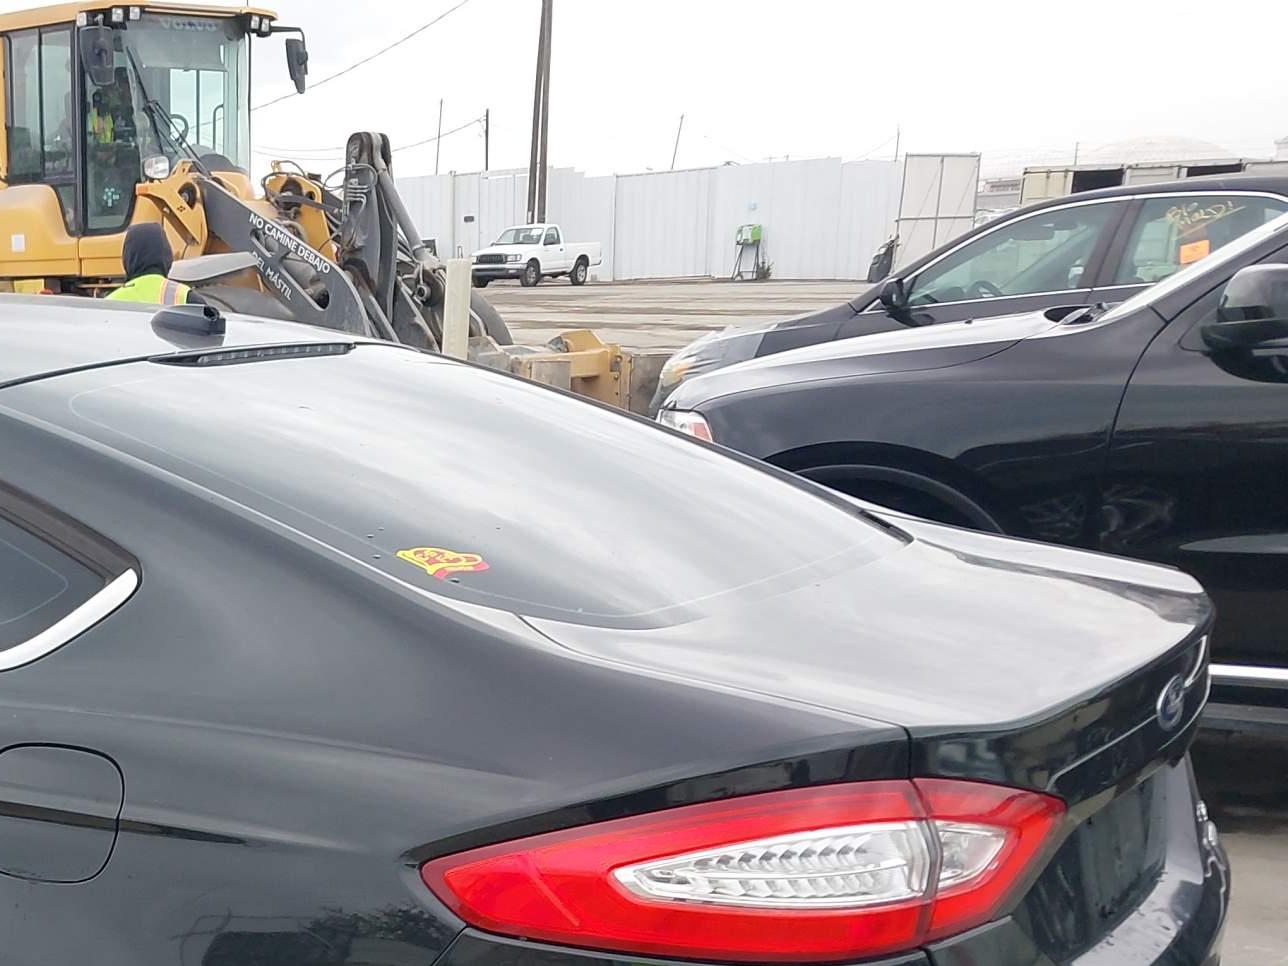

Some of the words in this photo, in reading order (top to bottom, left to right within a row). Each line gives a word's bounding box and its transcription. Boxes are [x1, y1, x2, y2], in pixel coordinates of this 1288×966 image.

[249, 213, 264, 229] NO
[264, 223, 297, 251] CAMINE
[297, 246, 330, 274] DEBAJO
[265, 266, 292, 301] MÁSTIL
